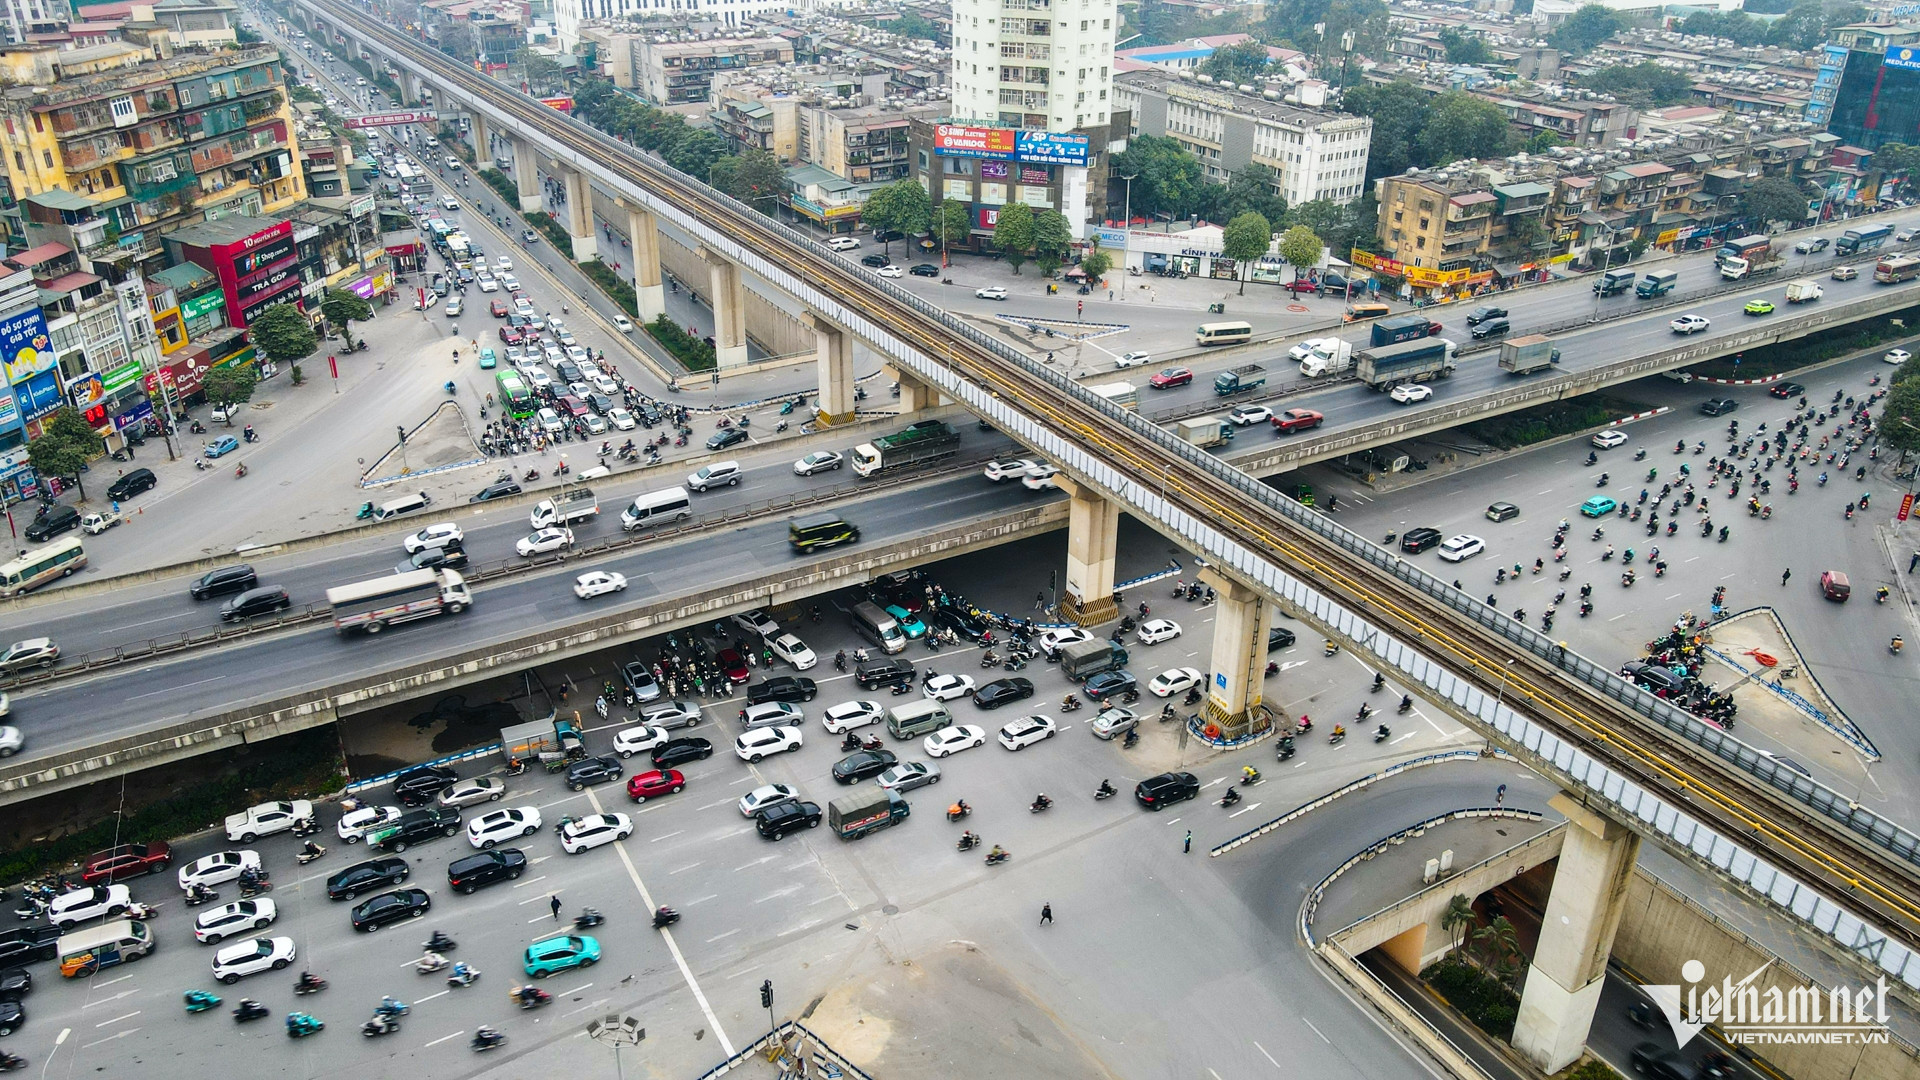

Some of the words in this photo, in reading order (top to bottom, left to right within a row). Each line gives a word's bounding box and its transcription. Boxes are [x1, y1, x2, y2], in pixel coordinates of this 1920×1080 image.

[1032, 133, 1047, 142] SP
[243, 238, 253, 248] 10
[245, 253, 261, 270] FPT
[260, 246, 288, 262] Shop.com.vn
[1181, 247, 1207, 257] KÍNH
[1261, 256, 1288, 265] NAM
[270, 271, 287, 284] GÓP
[0, 321, 12, 336] ĐỒ
[12, 319, 22, 332] SƠ
[22, 314, 40, 327] SINH
[23, 324, 37, 338] TỐT
[33, 384, 56, 398] KidsPlaza
